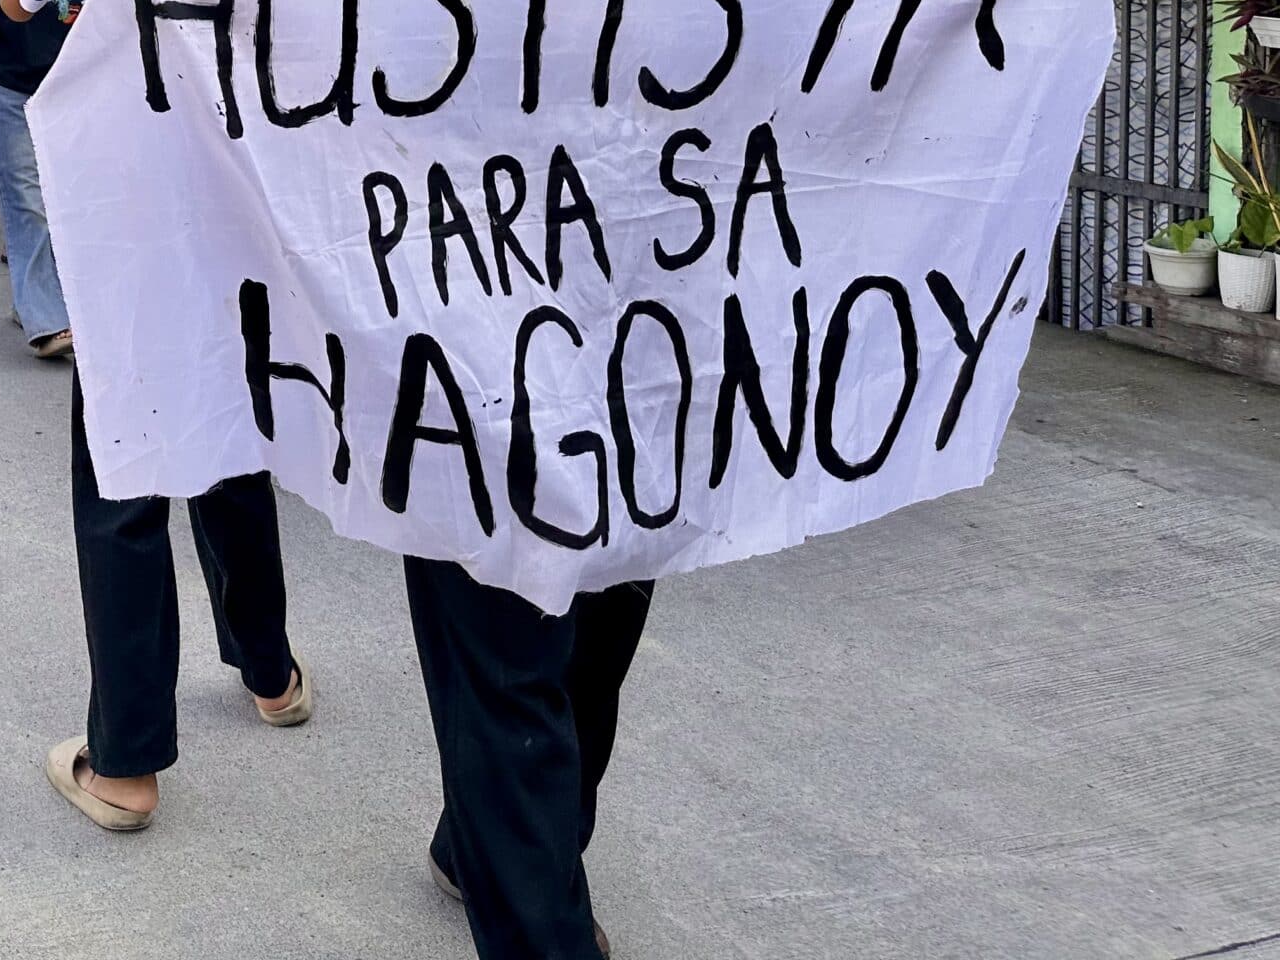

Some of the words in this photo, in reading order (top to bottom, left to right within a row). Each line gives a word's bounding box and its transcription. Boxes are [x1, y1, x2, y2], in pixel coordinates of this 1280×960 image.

[363, 145, 612, 319] PARA
[654, 122, 802, 280] SA
[239, 248, 1026, 551] HAGONOY
